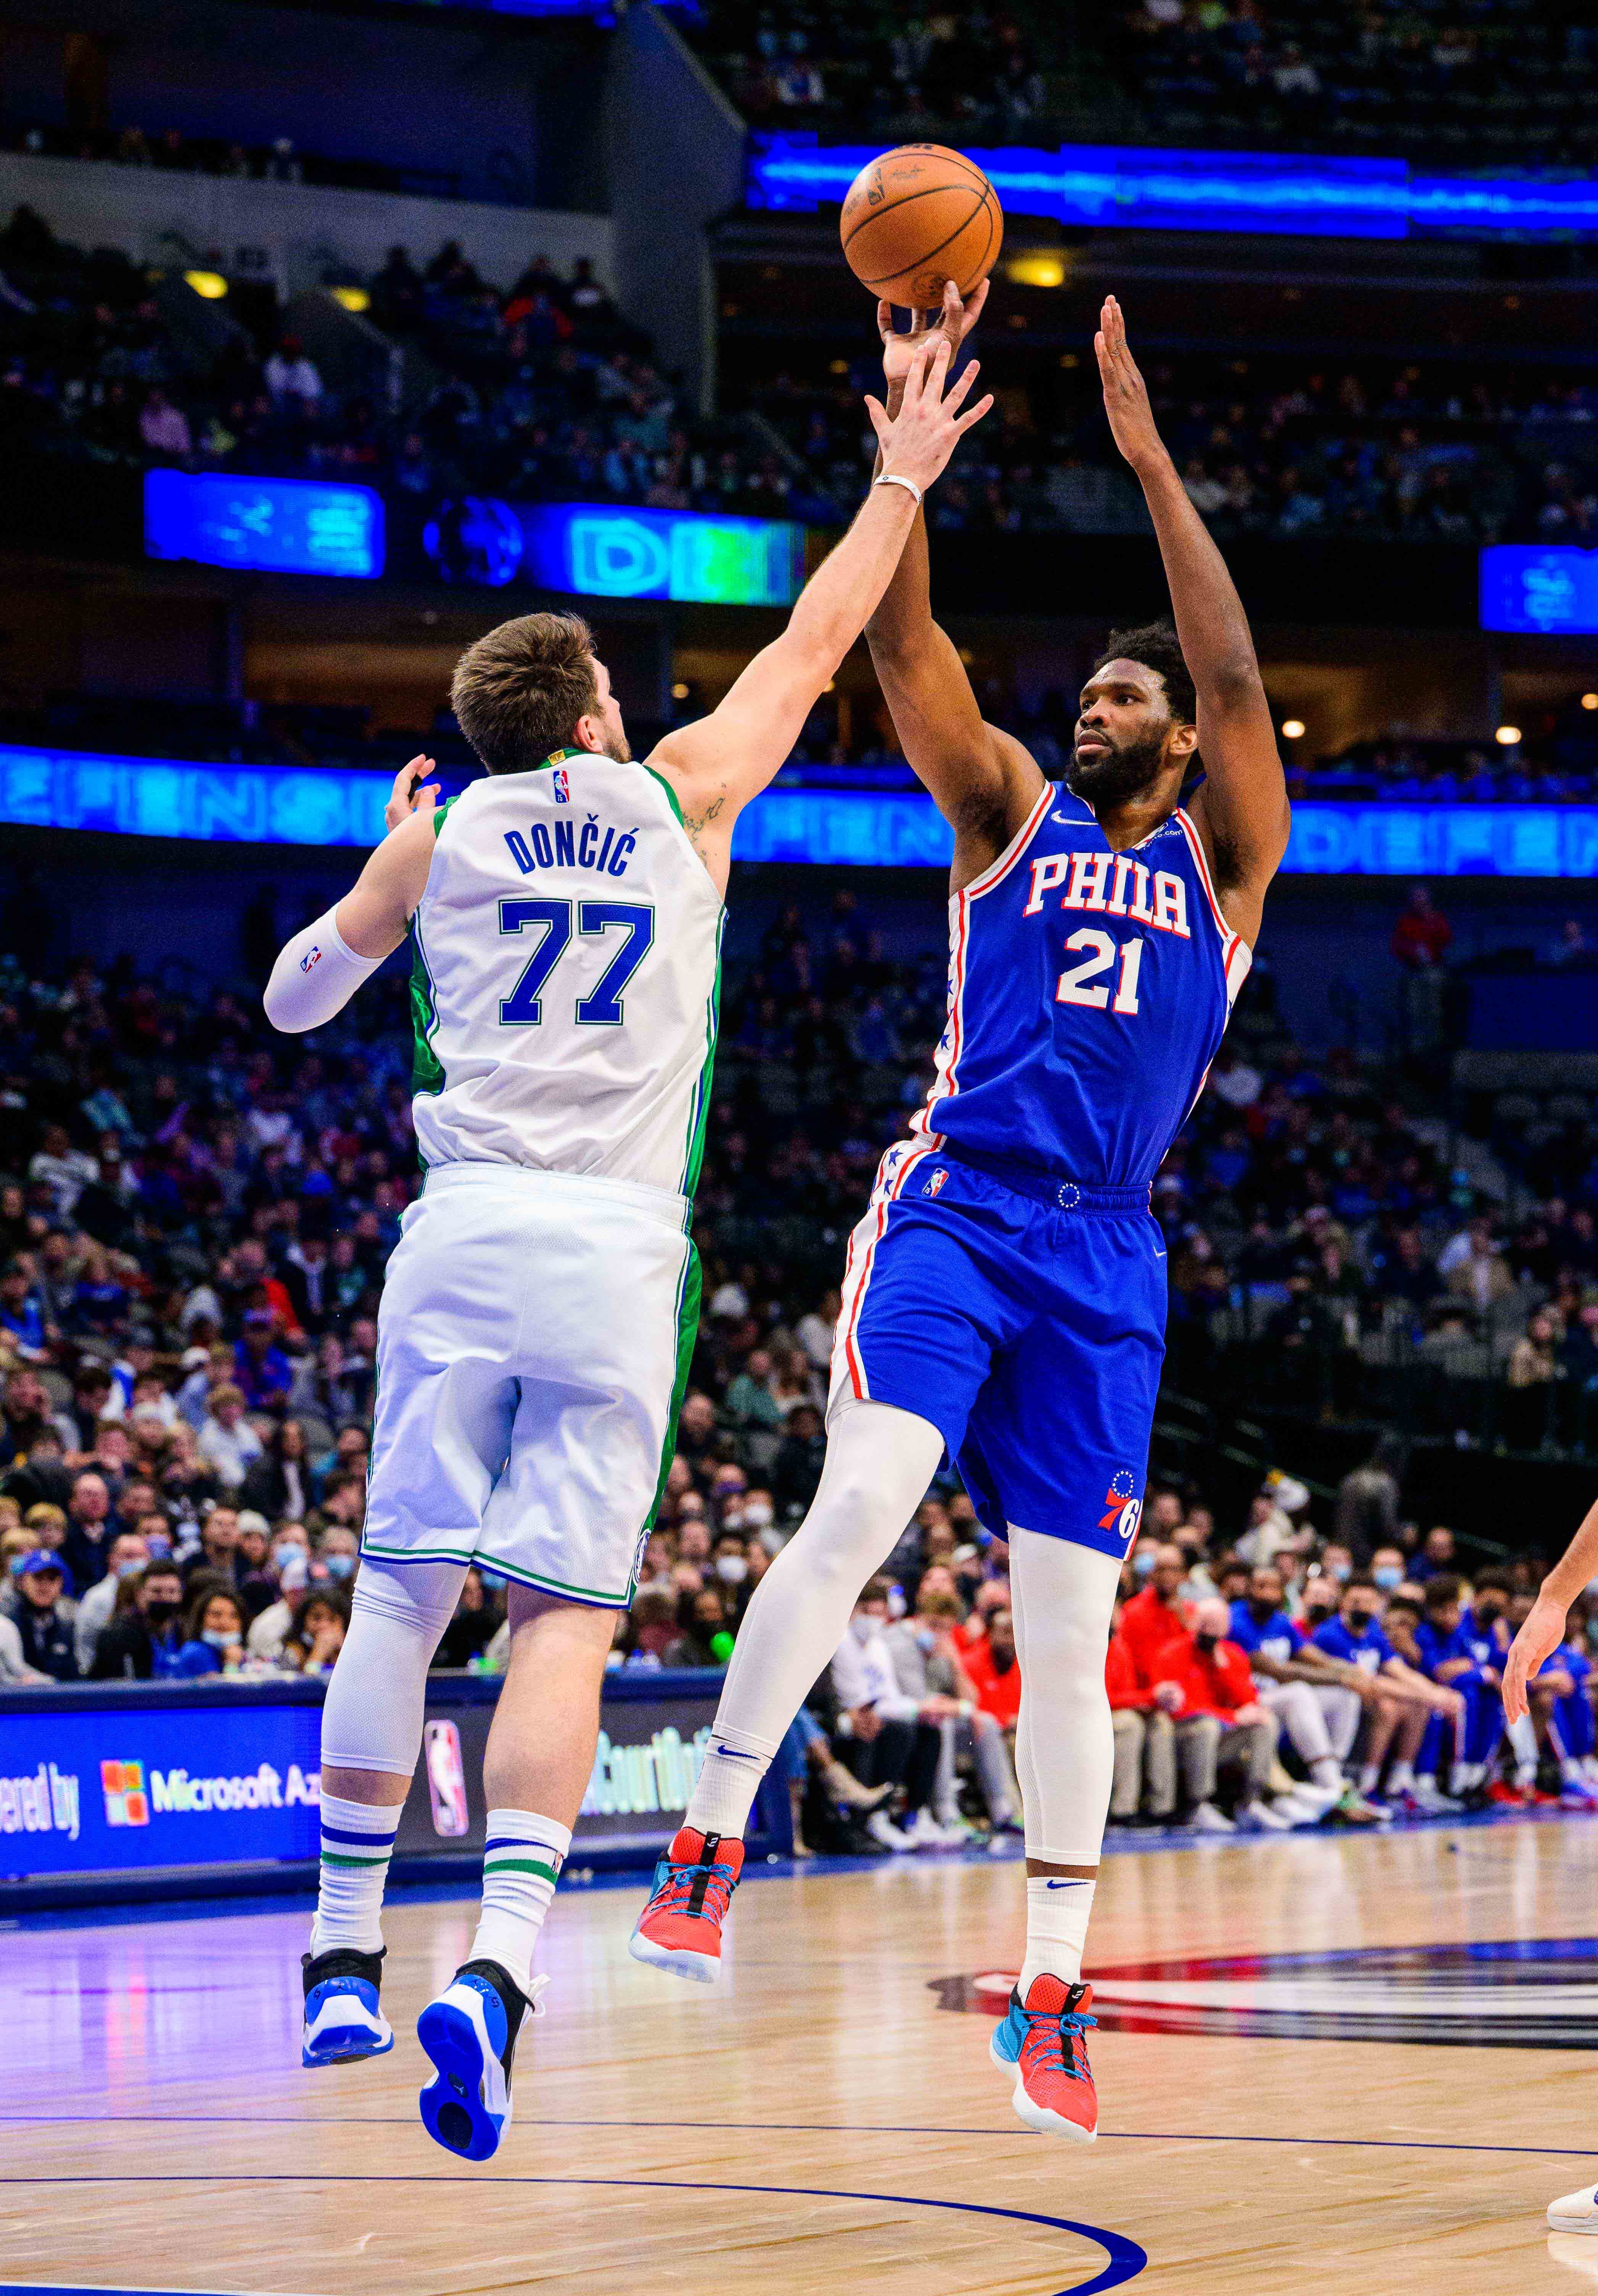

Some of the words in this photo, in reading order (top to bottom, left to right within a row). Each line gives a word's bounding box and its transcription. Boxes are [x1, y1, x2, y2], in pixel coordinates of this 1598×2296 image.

[503, 813, 640, 877] DONČIĆ
[1023, 852, 1190, 939] PHILA
[498, 898, 655, 1025] 77
[1055, 928, 1144, 1015] 21
[1096, 1487, 1140, 1539] 76
[150, 1762, 283, 1813] Microsoft
